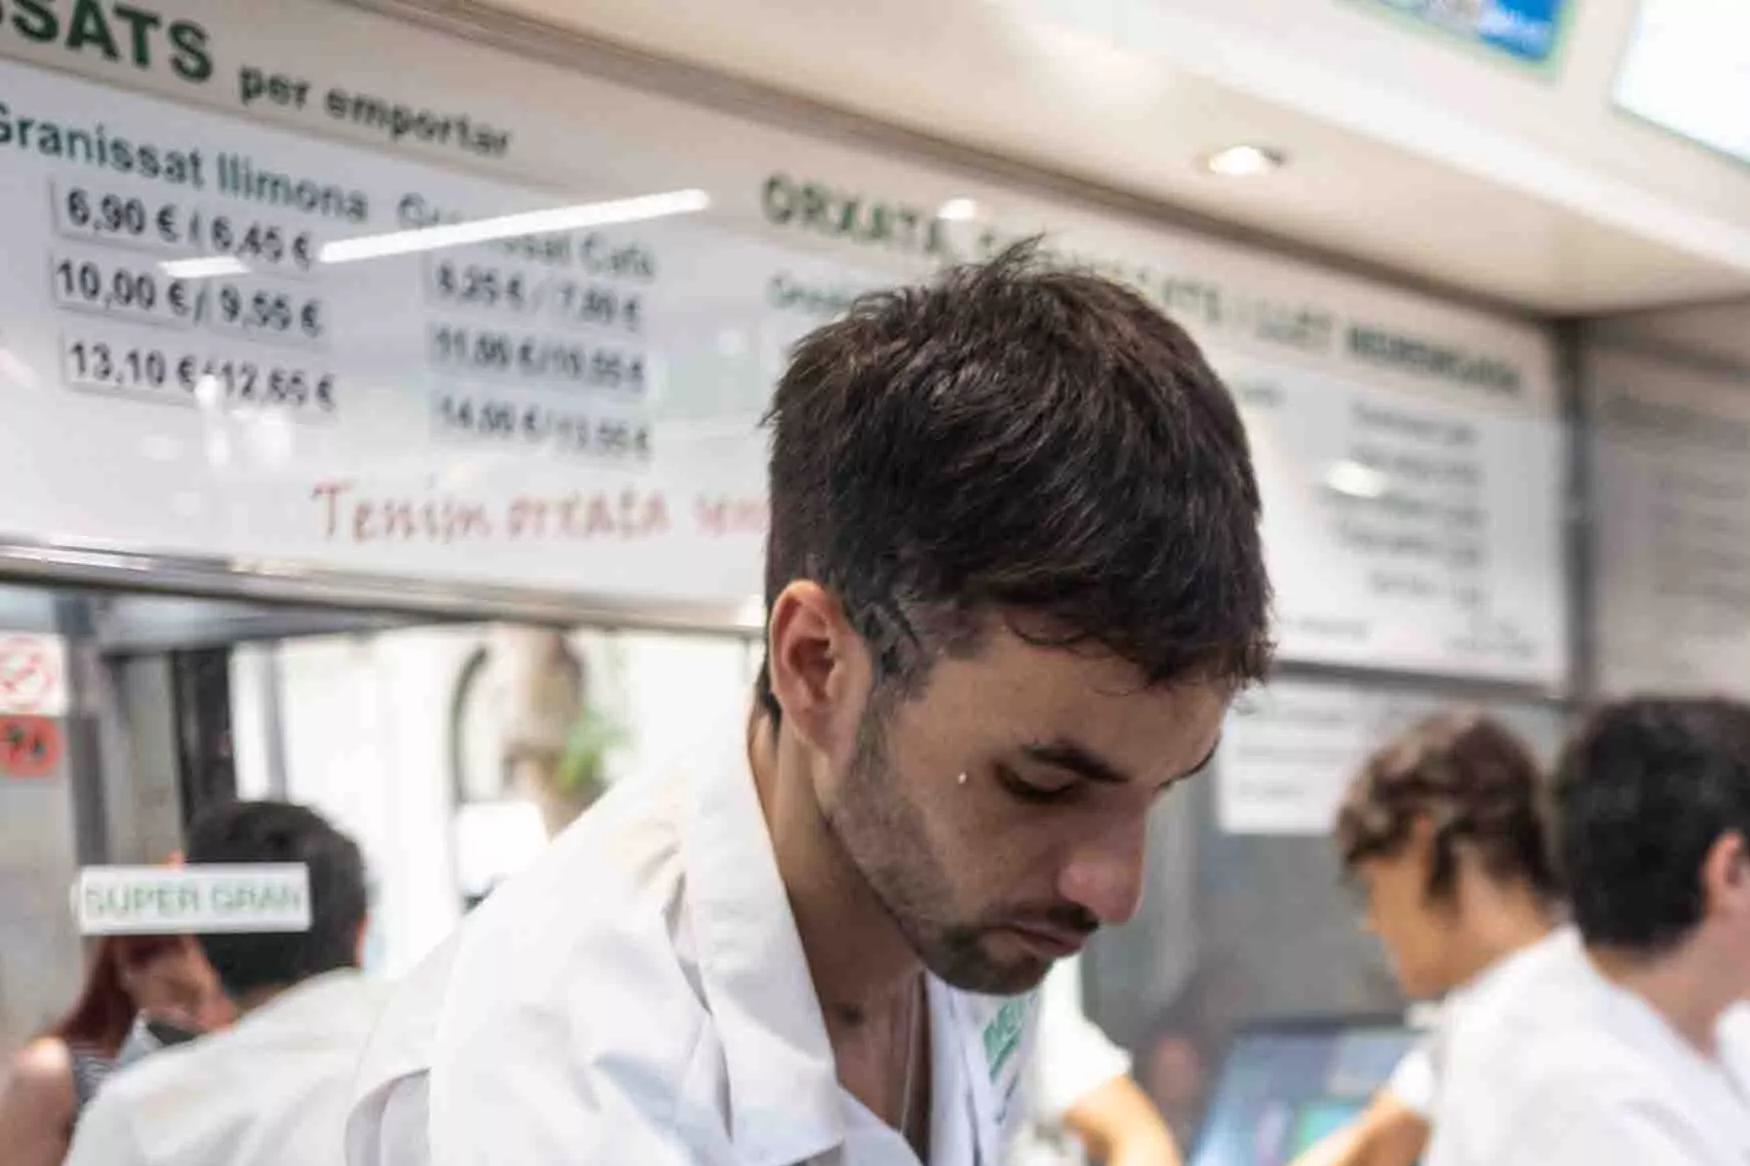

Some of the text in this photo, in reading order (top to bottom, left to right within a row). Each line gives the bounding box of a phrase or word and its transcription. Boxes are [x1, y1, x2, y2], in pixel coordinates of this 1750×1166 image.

[0, 0, 511, 159] SATS per emportar
[217, 150, 368, 223] llimona
[85, 884, 200, 915] SUPER
